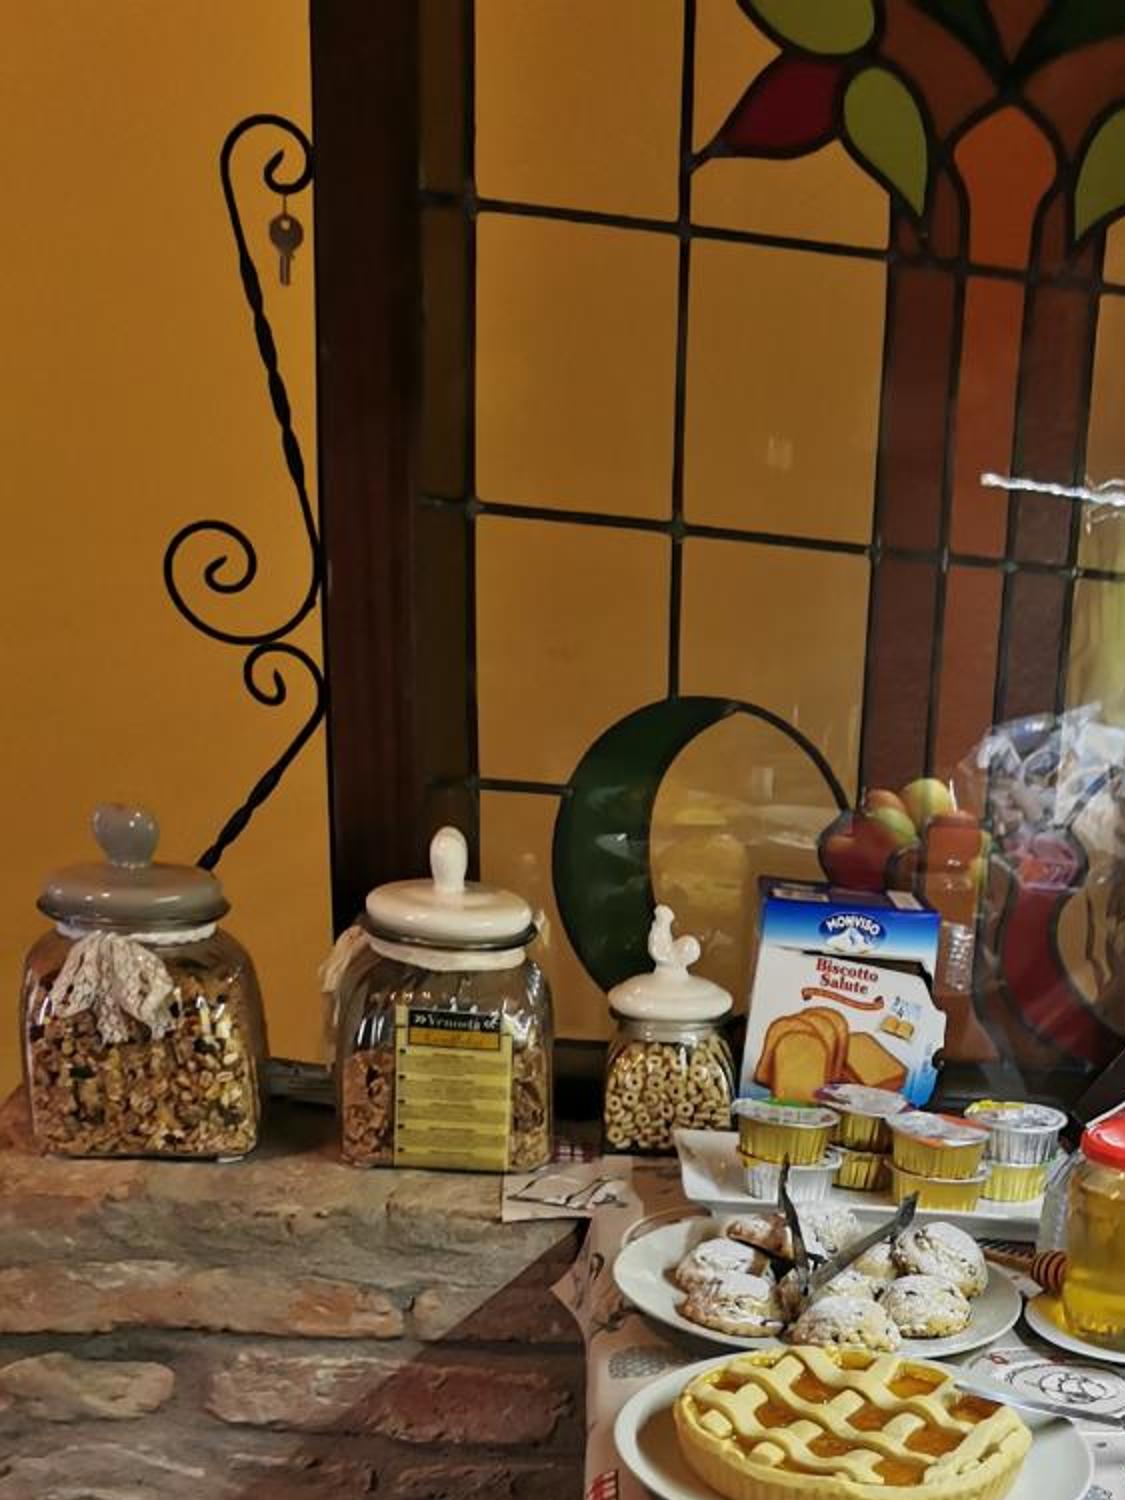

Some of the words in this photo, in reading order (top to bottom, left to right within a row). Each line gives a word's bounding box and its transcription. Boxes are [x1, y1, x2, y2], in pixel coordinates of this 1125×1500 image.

[825, 914, 881, 936] MONVISO
[816, 957, 880, 983] Biscotto
[820, 974, 869, 994] Salute
